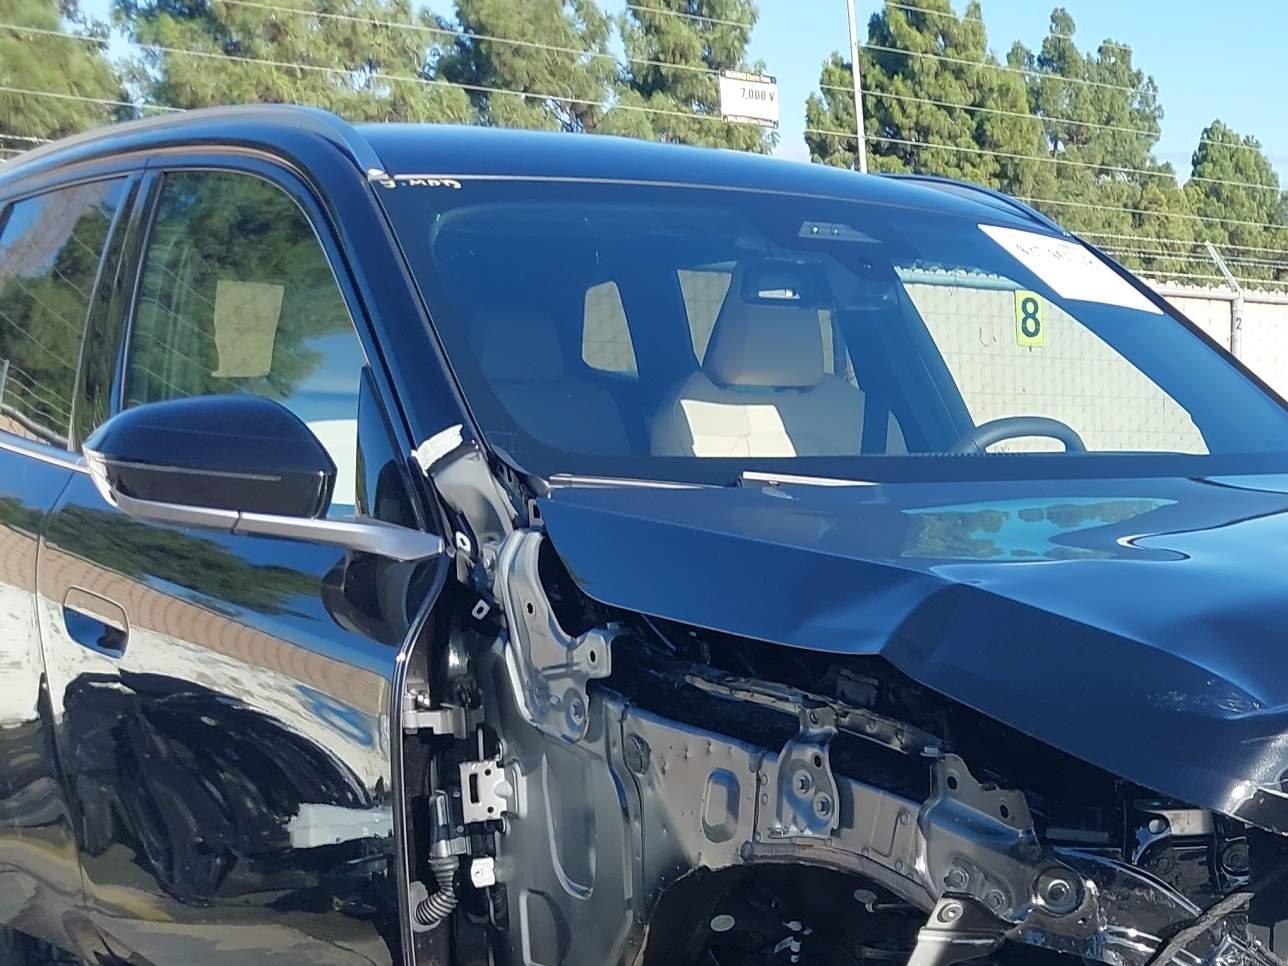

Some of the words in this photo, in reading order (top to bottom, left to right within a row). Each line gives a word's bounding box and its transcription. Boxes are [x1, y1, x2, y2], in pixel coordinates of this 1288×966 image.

[769, 92, 775, 102] V
[1021, 297, 1041, 338] 8
[1235, 316, 1242, 330] 2
